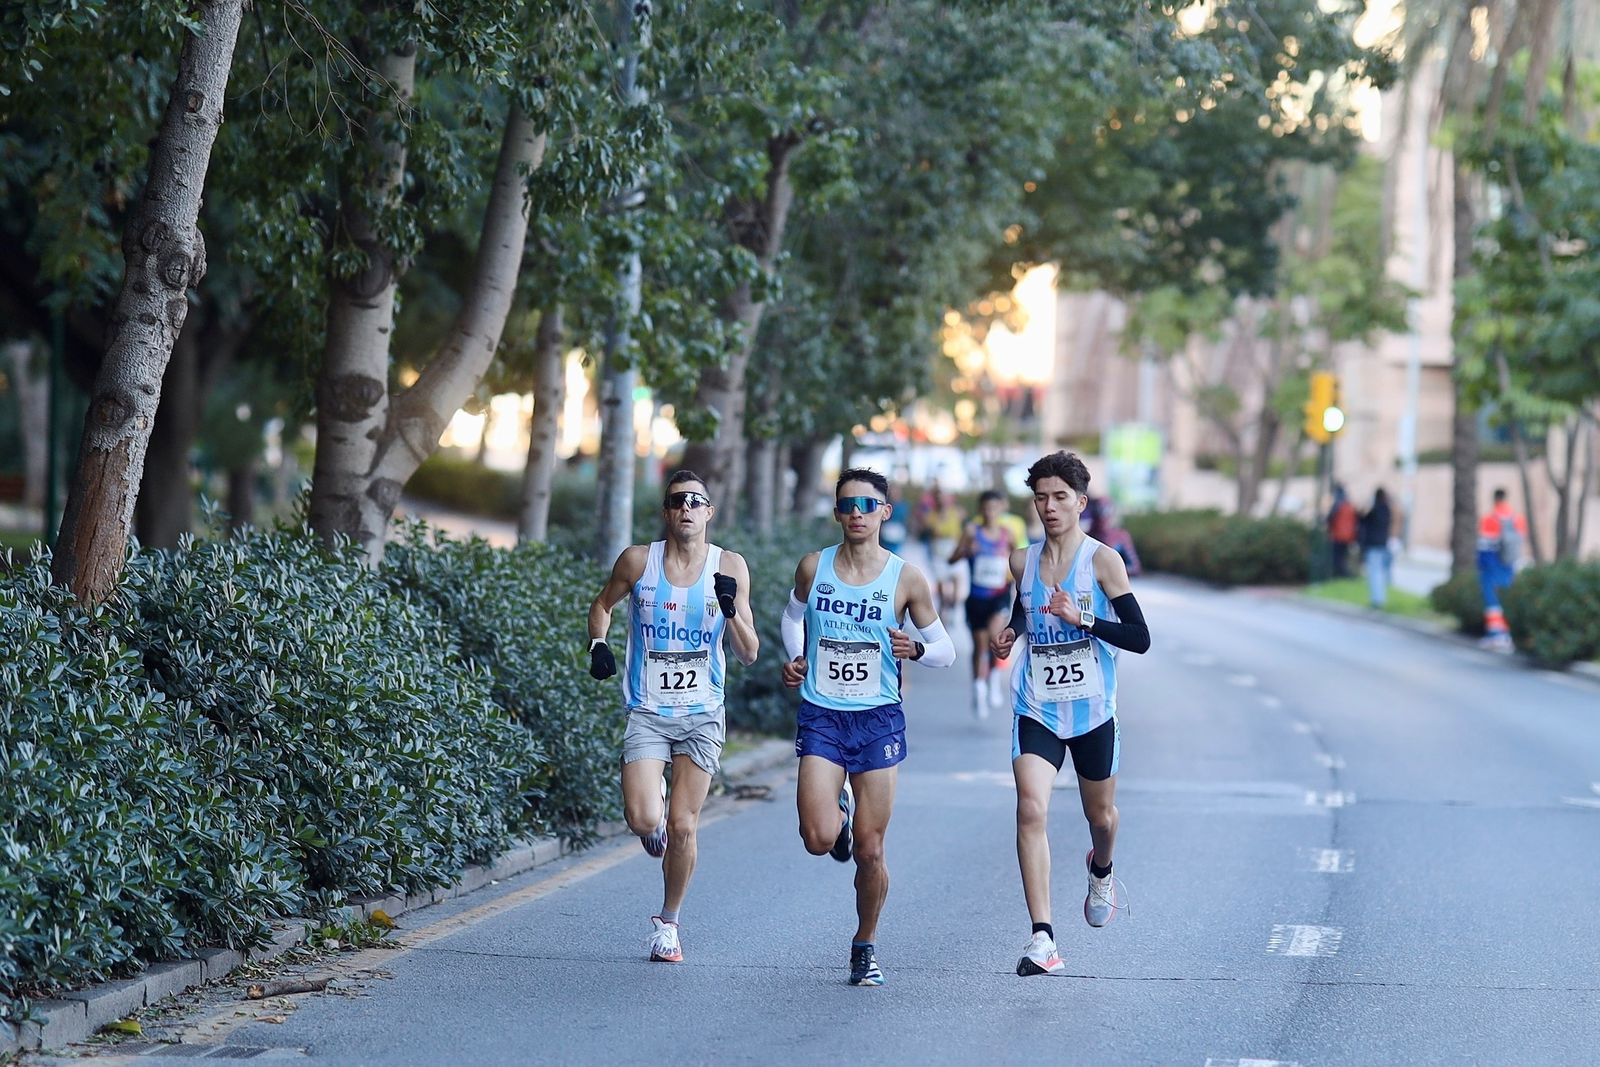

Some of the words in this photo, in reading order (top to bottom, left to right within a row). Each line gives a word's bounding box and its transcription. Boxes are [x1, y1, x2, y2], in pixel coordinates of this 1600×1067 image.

[815, 596, 882, 623] nerja
[823, 619, 872, 633] ATLETISMO
[660, 670, 697, 690] 122
[829, 661, 869, 682] 565
[1043, 663, 1085, 685] 225
